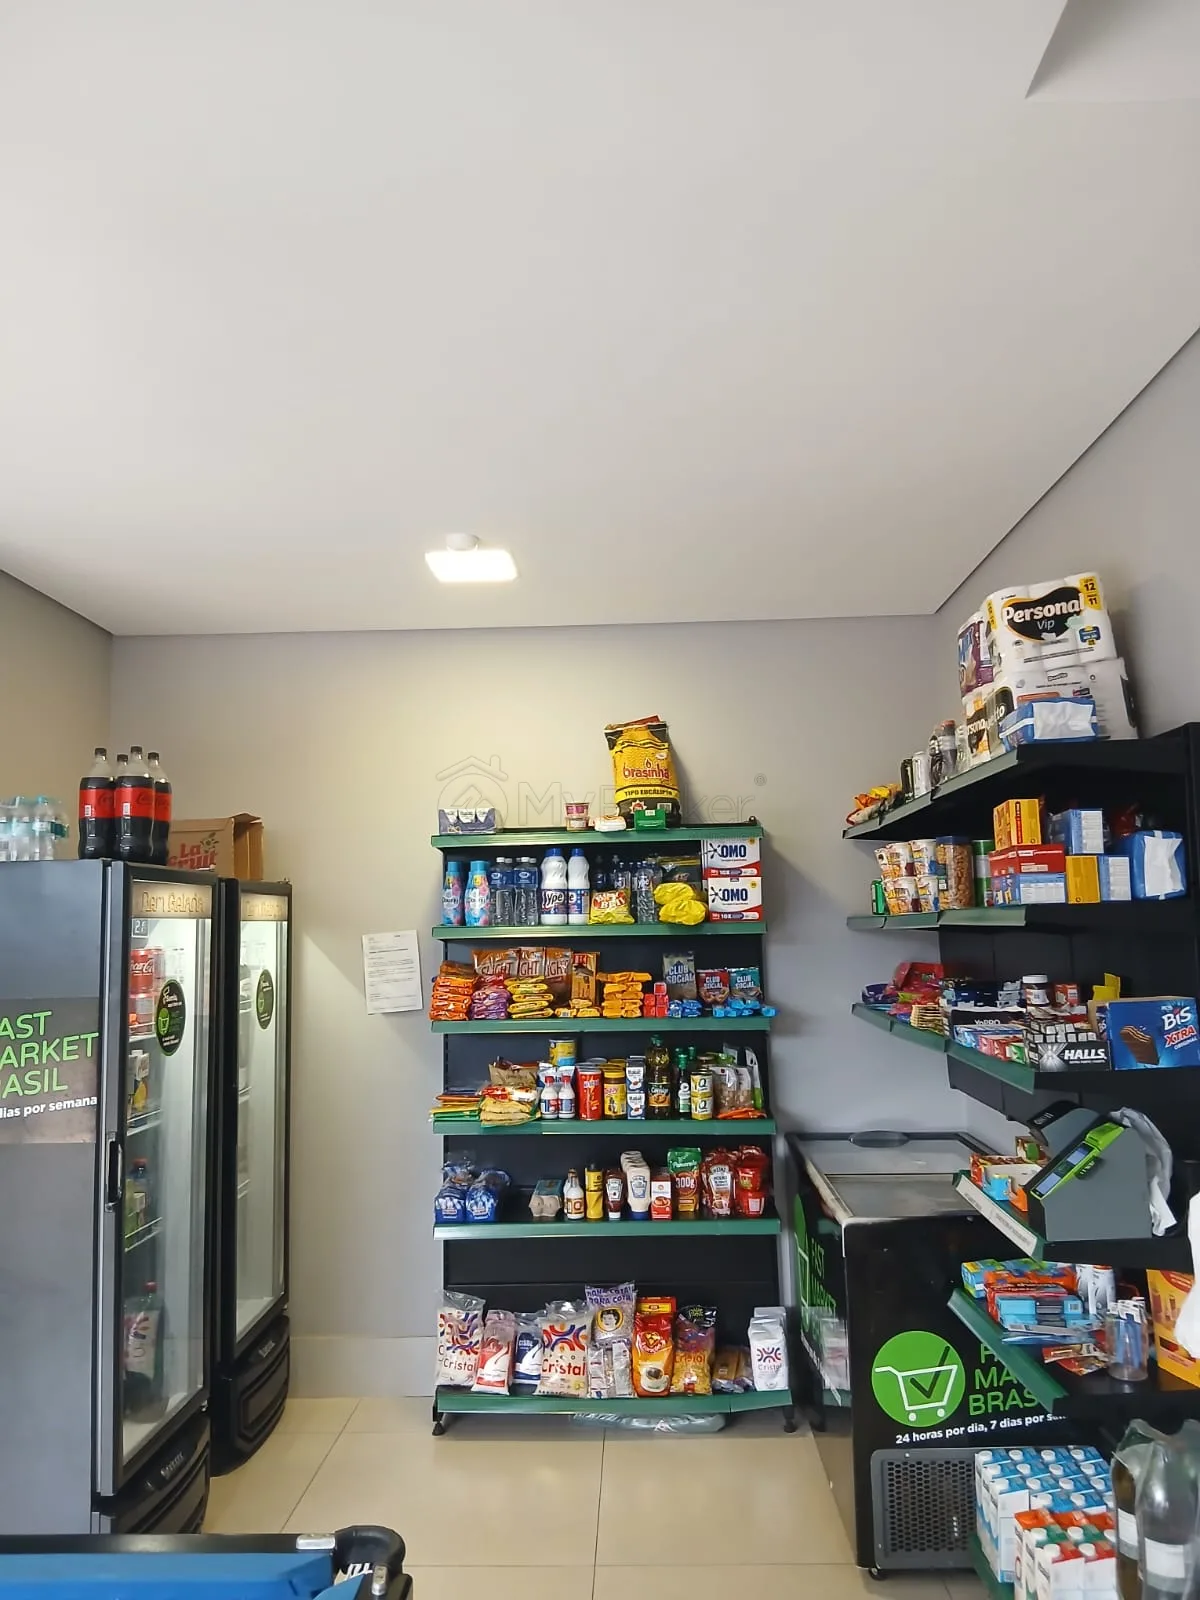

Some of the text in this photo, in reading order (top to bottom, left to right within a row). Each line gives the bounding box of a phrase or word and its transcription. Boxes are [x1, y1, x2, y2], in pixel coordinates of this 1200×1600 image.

[1084, 583, 1096, 592] 12
[1002, 593, 1084, 623] Personal
[1037, 619, 1055, 631] Vip
[623, 763, 670, 780] brasinha
[721, 844, 747, 858] OMO
[722, 888, 748, 902] OMO
[668, 964, 688, 975] CLUB
[705, 975, 720, 983] CLUB
[736, 975, 751, 983] CLUB
[1165, 1025, 1197, 1048] XTRA
[1174, 1037, 1198, 1050] ORIGINAL
[1064, 1048, 1107, 1060] HALLS
[0, 1067, 69, 1099] ASIL
[24, 1103, 46, 1117] por
[48, 1096, 98, 1112] semana
[676, 1176, 695, 1189] 300g
[443, 1359, 477, 1373] Cristal
[542, 1358, 587, 1376] Cristal
[758, 1363, 782, 1371] Cristal
[895, 1434, 910, 1444] 24
[912, 1430, 943, 1442] horas
[945, 1426, 965, 1439] por
[967, 1422, 988, 1433] dia,
[990, 1420, 997, 1430] 7
[1000, 1418, 1022, 1429] dias
[1024, 1414, 1044, 1426] por
